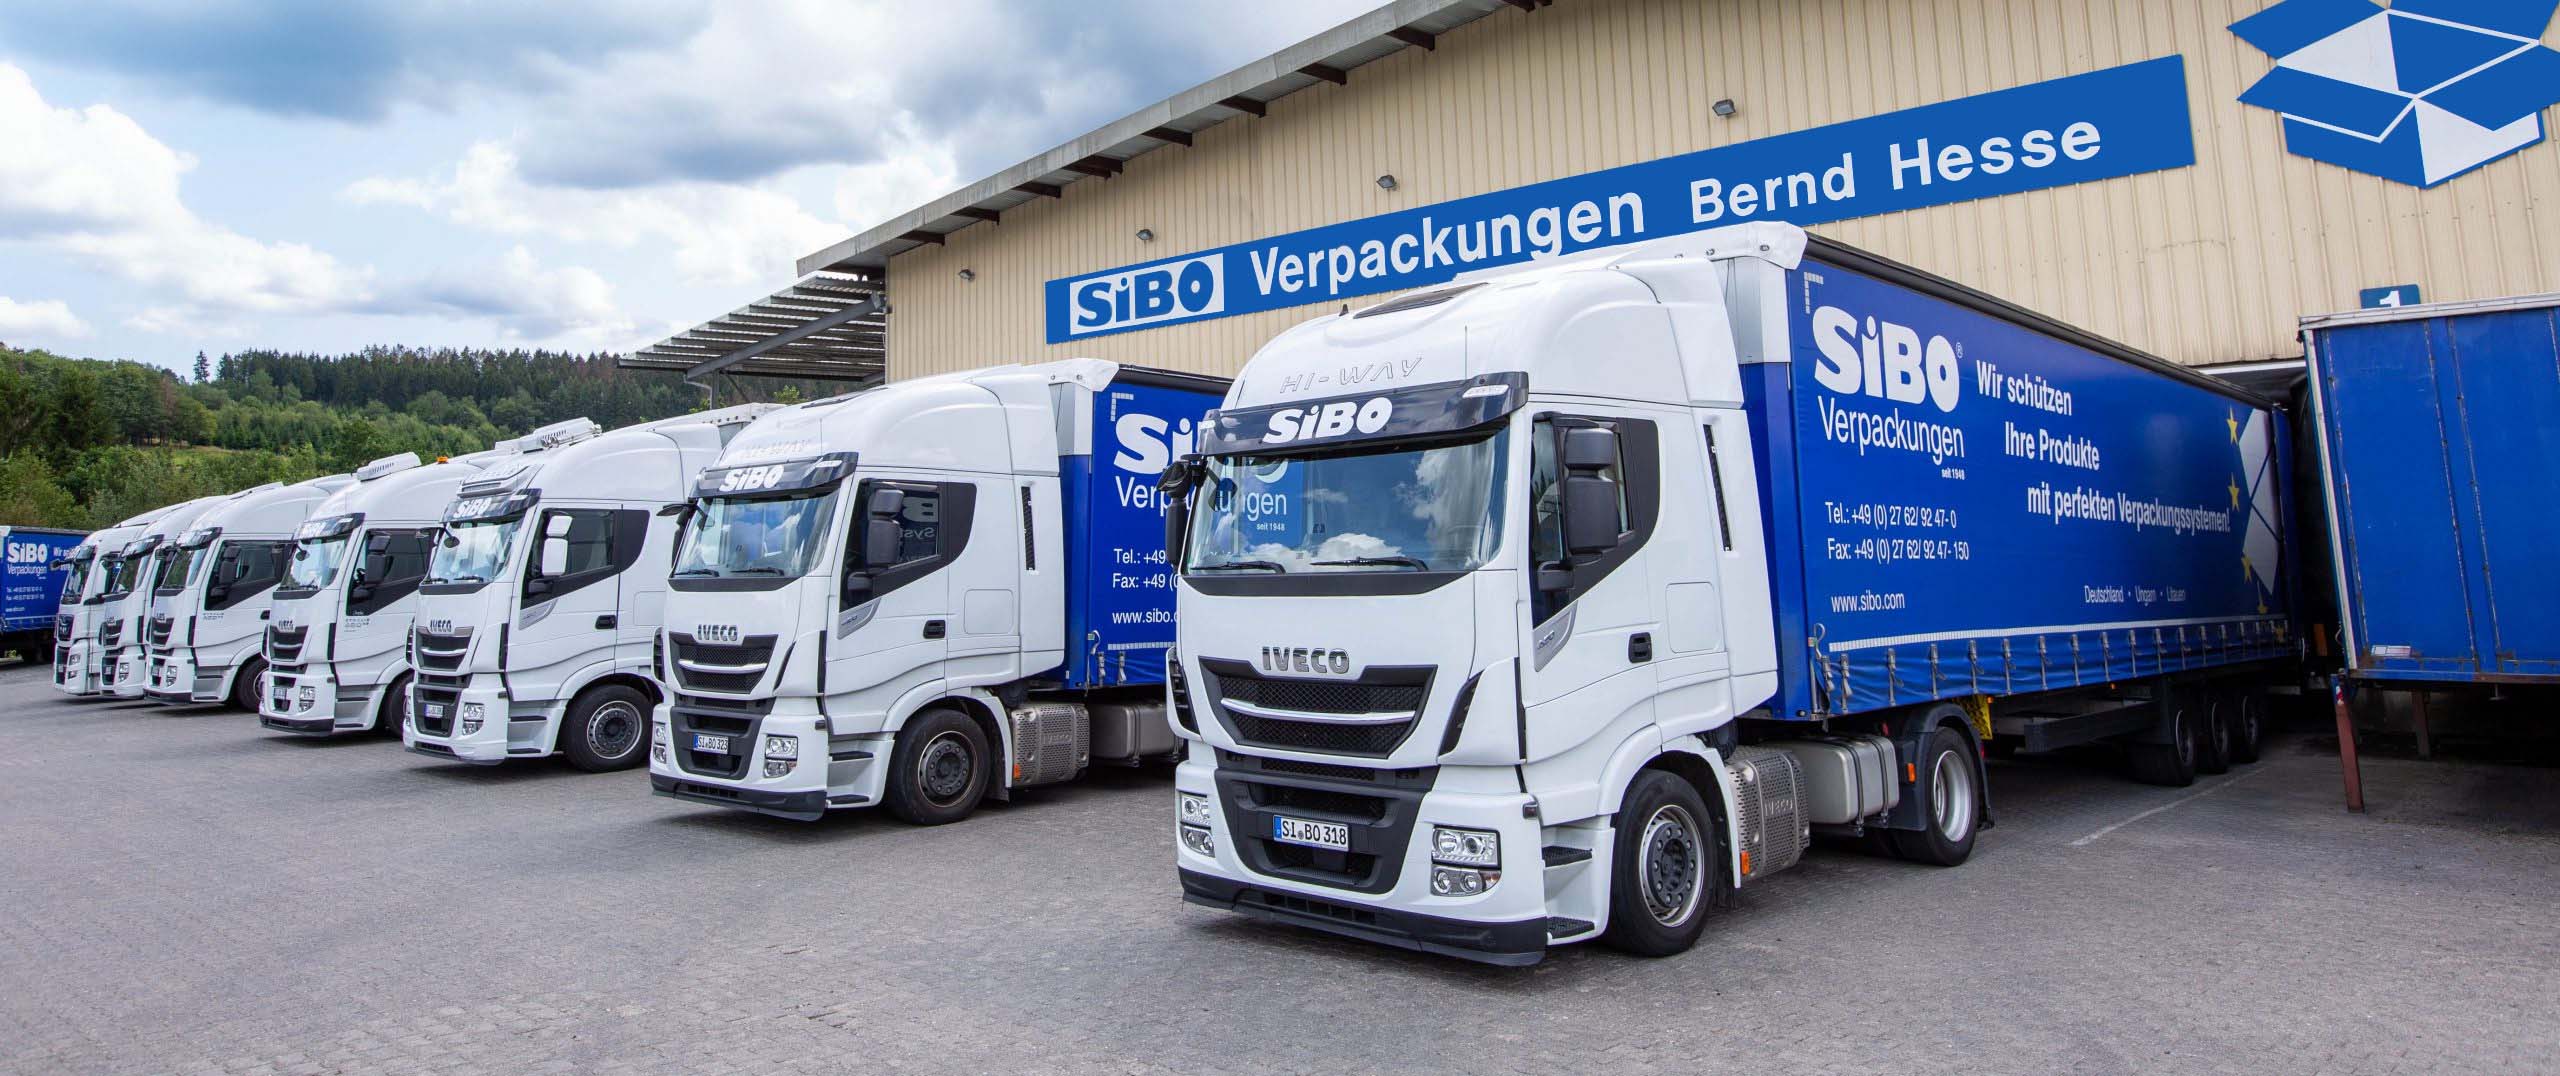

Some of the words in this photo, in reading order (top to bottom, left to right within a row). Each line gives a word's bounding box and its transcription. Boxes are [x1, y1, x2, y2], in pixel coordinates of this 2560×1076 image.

[1077, 260, 1214, 328] SiBO
[1250, 192, 1645, 296] Verpackungen
[1690, 152, 1856, 224] Bernd
[1890, 121, 2101, 190] Hesse
[1976, 359, 2003, 399] Wir
[2007, 373, 2072, 416] schützen
[1261, 397, 1393, 444] SiBO
[1817, 395, 1965, 465] Verpackungen
[2005, 421, 2035, 459] Ihre
[2039, 428, 2100, 471] Produkte
[1825, 501, 1850, 524] Tel.:
[1851, 503, 1871, 525] +49
[1873, 503, 1888, 530] (0)
[1889, 506, 1902, 526] 27
[1920, 507, 1933, 527] 92
[2027, 481, 2051, 515] mit
[2054, 486, 2115, 524] perfekten
[2117, 492, 2231, 536] Verpackungssystemen!
[1113, 548, 1141, 564] Tel.:
[1143, 549, 1166, 564] +49
[1827, 537, 1851, 560] Fax:
[1854, 538, 1873, 560] +49
[1876, 538, 1890, 564] (0)
[1892, 539, 1904, 559] 27
[1923, 540, 1935, 560] 92
[1953, 541, 1969, 560] 150
[1112, 572, 1139, 588] Fax:
[1143, 573, 1166, 588] +49
[2084, 584, 2124, 603] Deutschland
[1831, 589, 1906, 613] www.sibo.com
[697, 623, 738, 642] IVECO
[1262, 646, 1350, 675] IVECO
[1282, 820, 1297, 838] SI
[1304, 823, 1321, 842] BO
[1323, 826, 1347, 845] 318
